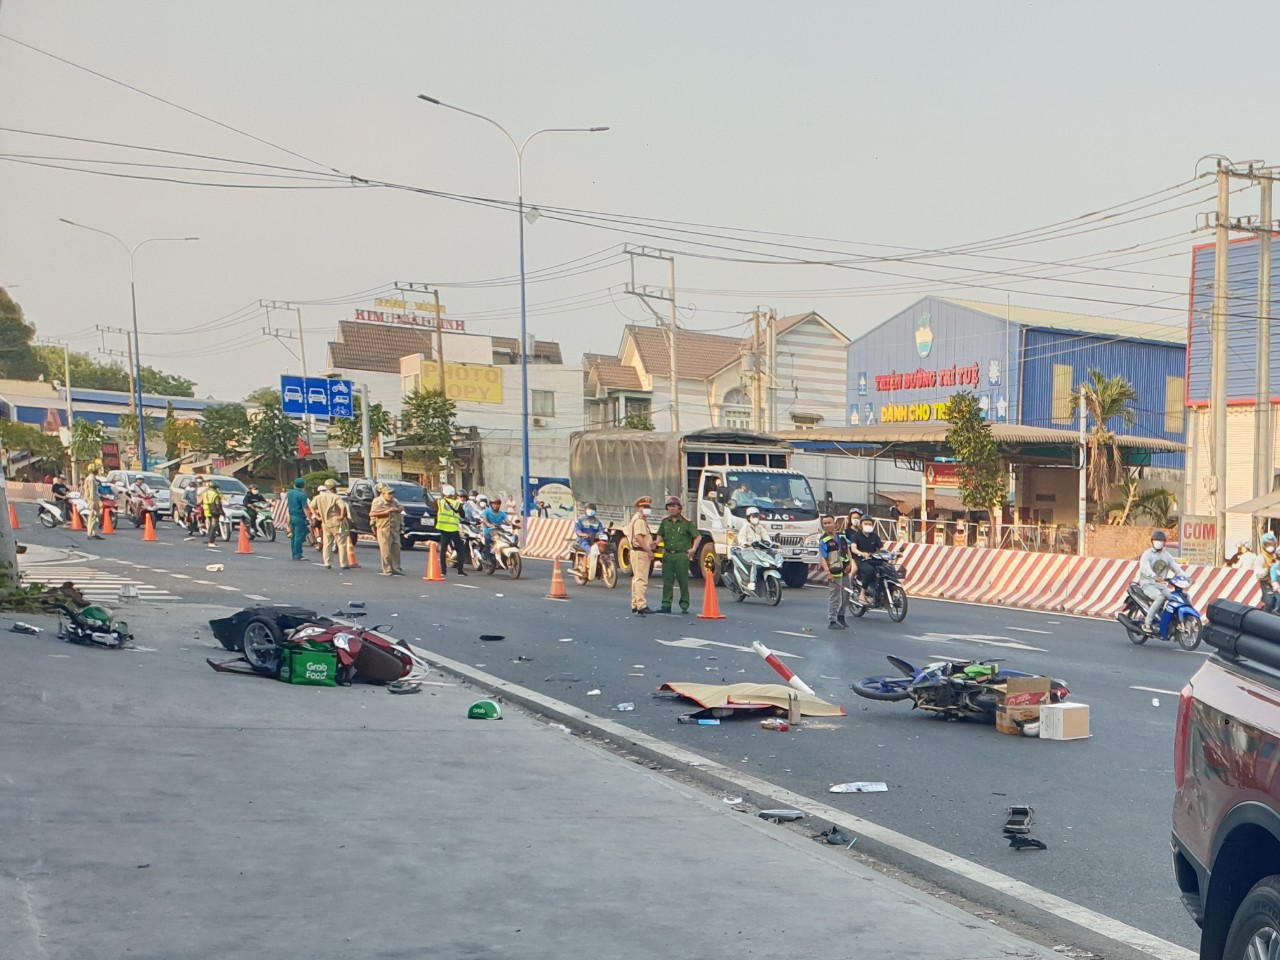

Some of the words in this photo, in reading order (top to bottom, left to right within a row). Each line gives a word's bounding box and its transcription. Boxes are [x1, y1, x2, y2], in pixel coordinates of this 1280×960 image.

[423, 364, 499, 384] PHOTO
[938, 364, 957, 387] TRÍ
[958, 362, 979, 389] TUỆ
[908, 404, 931, 421] CHO
[767, 513, 790, 521] JAC
[306, 661, 328, 672] Grab
[306, 670, 328, 680] Food
